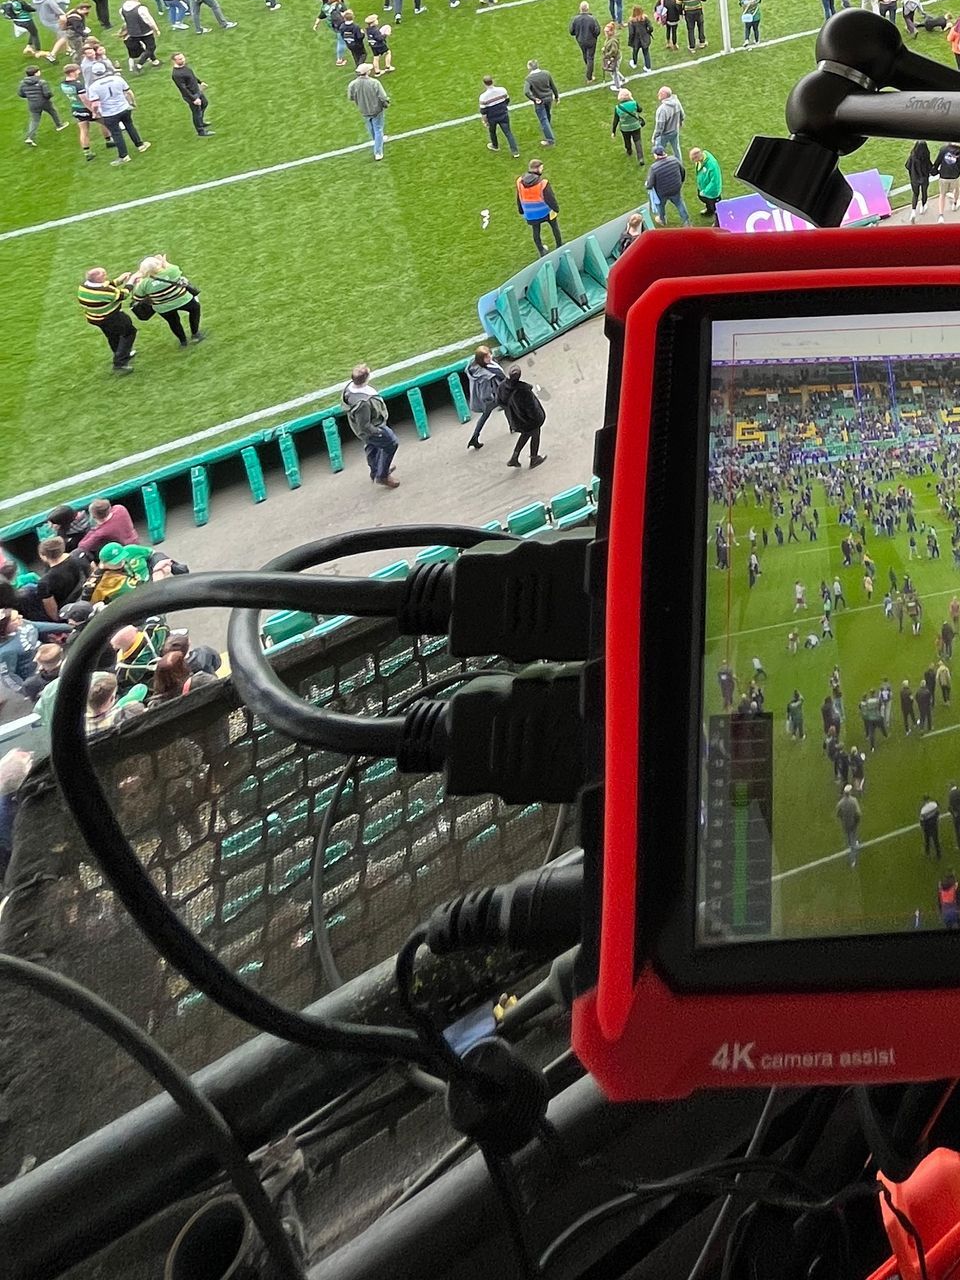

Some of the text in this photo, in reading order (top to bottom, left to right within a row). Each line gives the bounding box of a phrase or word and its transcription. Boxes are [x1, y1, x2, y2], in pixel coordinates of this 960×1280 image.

[711, 1041, 896, 1070] 4K camera assist
